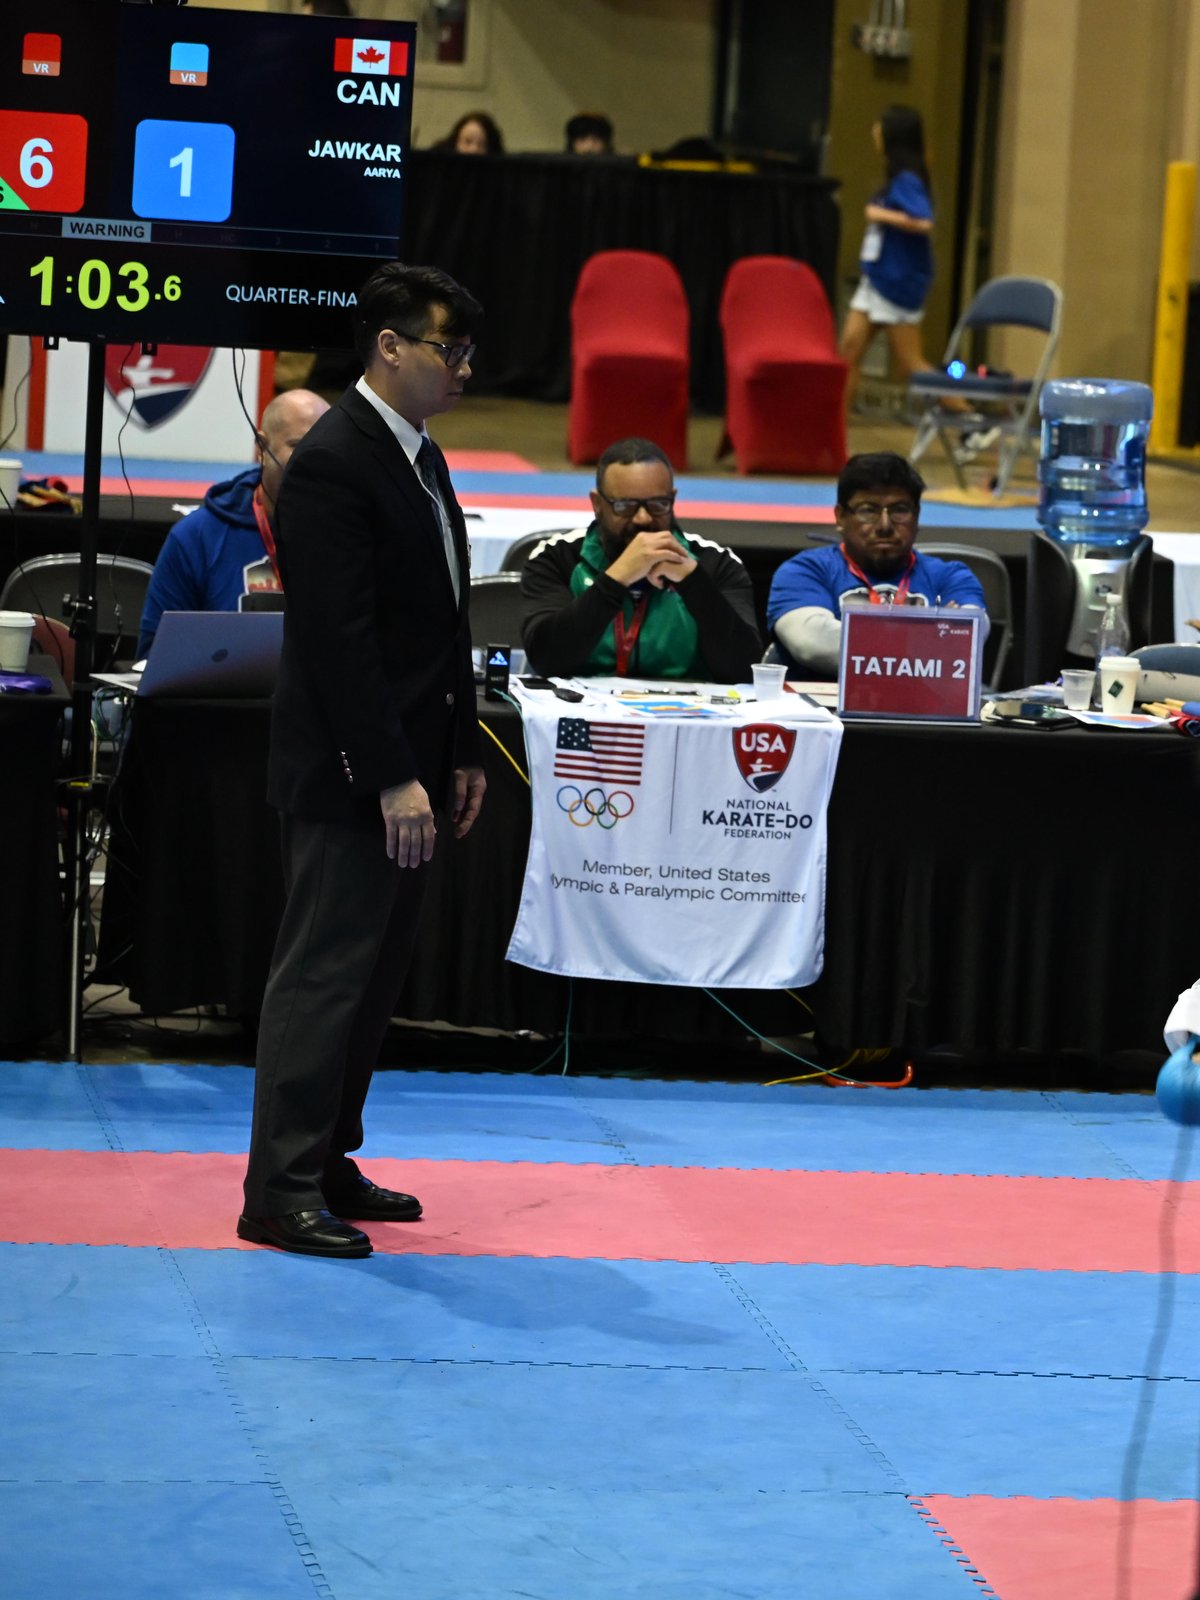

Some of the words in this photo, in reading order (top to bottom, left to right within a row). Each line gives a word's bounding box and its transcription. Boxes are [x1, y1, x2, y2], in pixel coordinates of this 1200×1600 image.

[33, 63, 49, 74] VR
[181, 73, 197, 83] VR
[337, 80, 400, 106] CAN
[308, 140, 401, 163] JAWKAR
[19, 137, 54, 189] 6
[169, 147, 194, 197] 1
[364, 166, 401, 179] AARYA
[70, 221, 145, 239] WARNING
[851, 656, 942, 678] TATAMI
[952, 659, 966, 679] 2
[741, 732, 787, 753] USA
[726, 799, 792, 811] NATIONAL
[702, 810, 813, 829] KARATE-DO
[724, 828, 791, 840] FEDERATION
[582, 859, 652, 879] Member,
[659, 865, 712, 880] United
[718, 868, 771, 883] States
[550, 873, 604, 893] lympic
[609, 881, 620, 895] &
[625, 882, 715, 901] Paralympic
